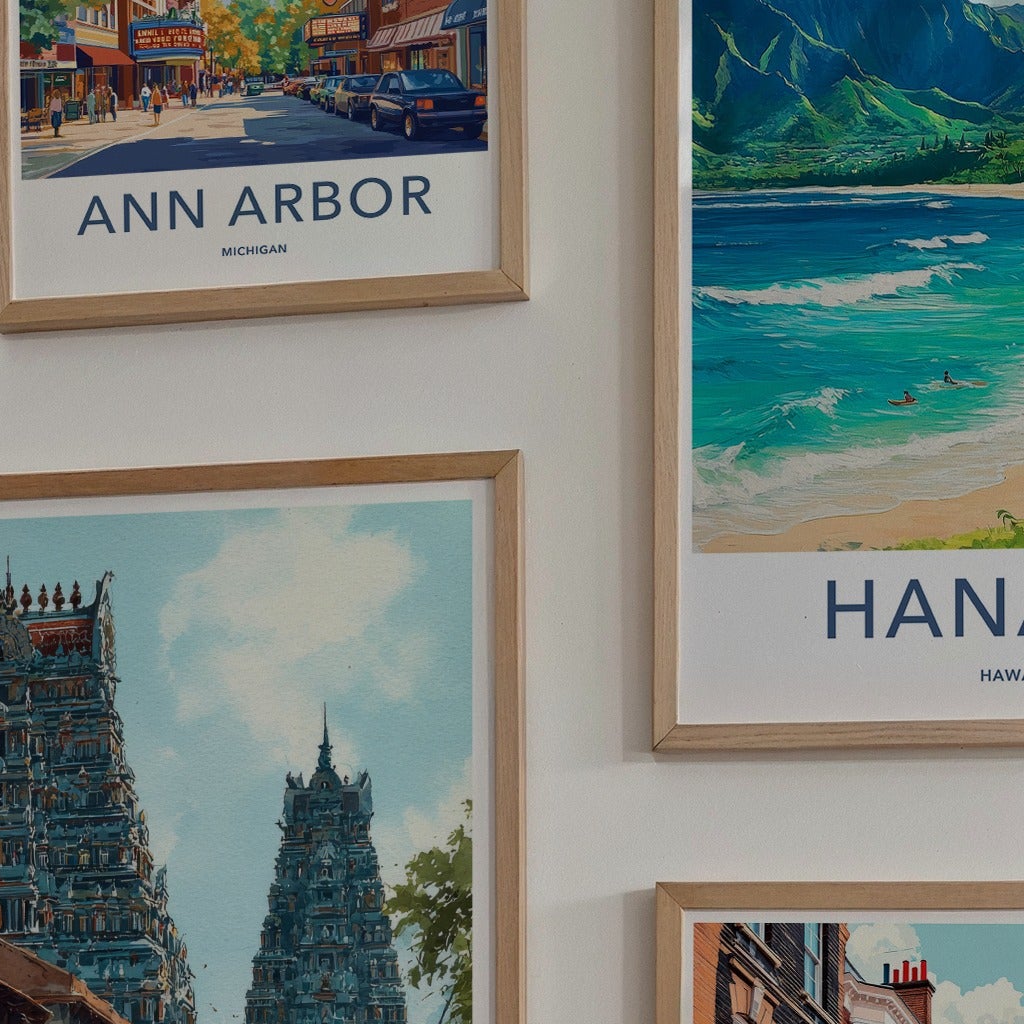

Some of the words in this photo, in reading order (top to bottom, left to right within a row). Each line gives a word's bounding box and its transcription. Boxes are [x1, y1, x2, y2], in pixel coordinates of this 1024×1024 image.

[77, 188, 204, 236] ANN
[228, 175, 432, 227] ARBOR
[221, 243, 287, 257] MICHIGAN
[826, 577, 1024, 640] HAN
[980, 668, 1024, 682] HAW
